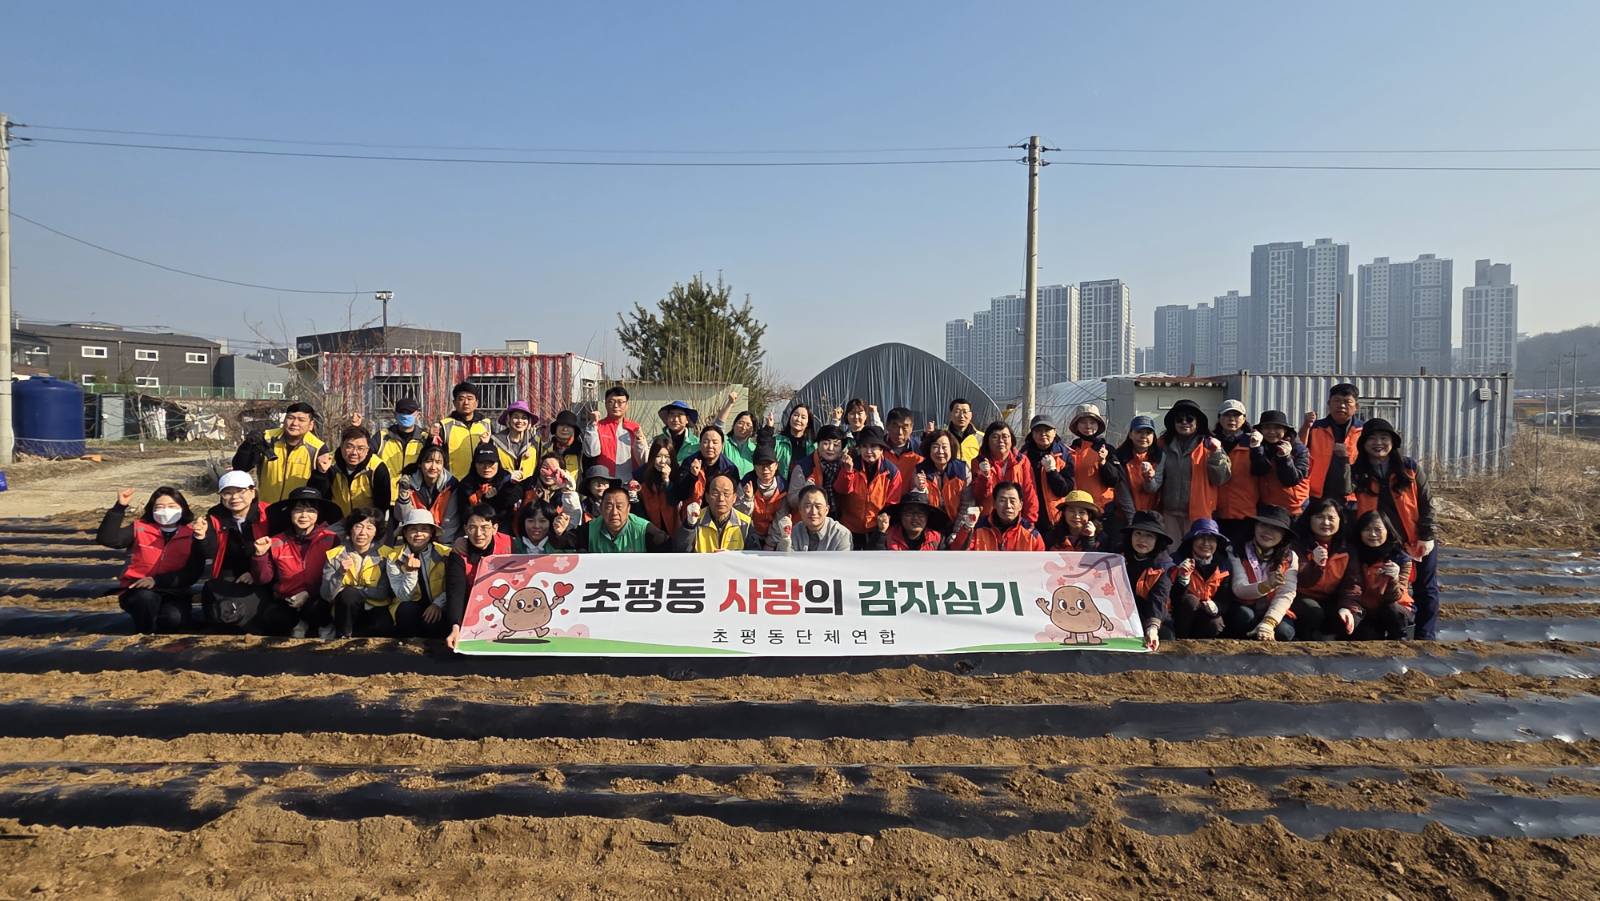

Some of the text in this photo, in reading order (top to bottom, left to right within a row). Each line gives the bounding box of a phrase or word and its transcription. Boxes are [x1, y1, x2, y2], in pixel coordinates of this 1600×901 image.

[579, 578, 1024, 617] 초평동 사랑의 감자심기
[711, 628, 896, 645] 초평동단체연합
